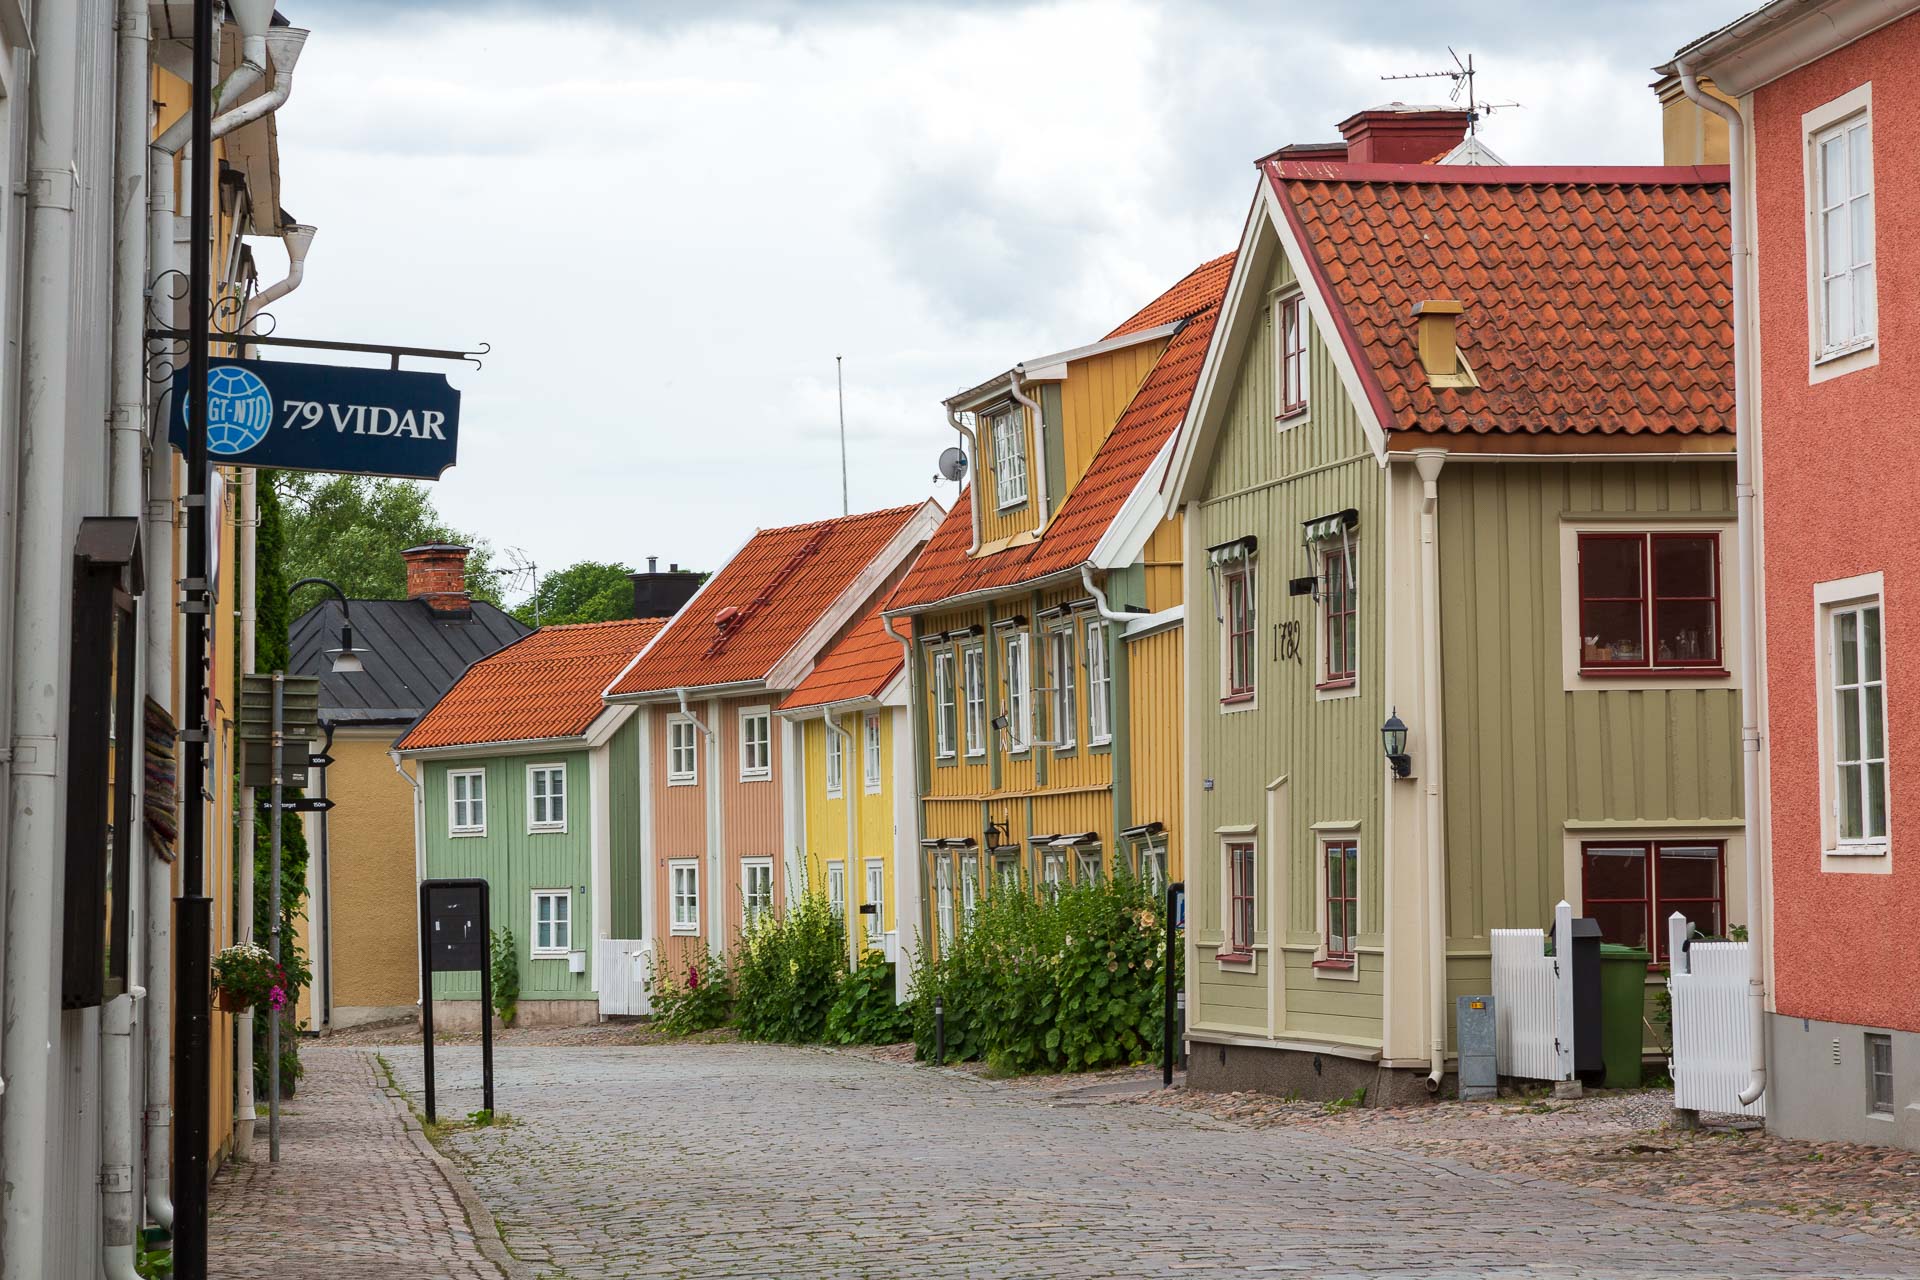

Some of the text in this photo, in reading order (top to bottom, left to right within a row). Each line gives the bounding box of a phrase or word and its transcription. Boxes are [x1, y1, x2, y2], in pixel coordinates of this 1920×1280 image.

[208, 395, 267, 431] GT-NTO
[282, 399, 446, 440] 79 VIDAR
[1273, 620, 1302, 666] 1782
